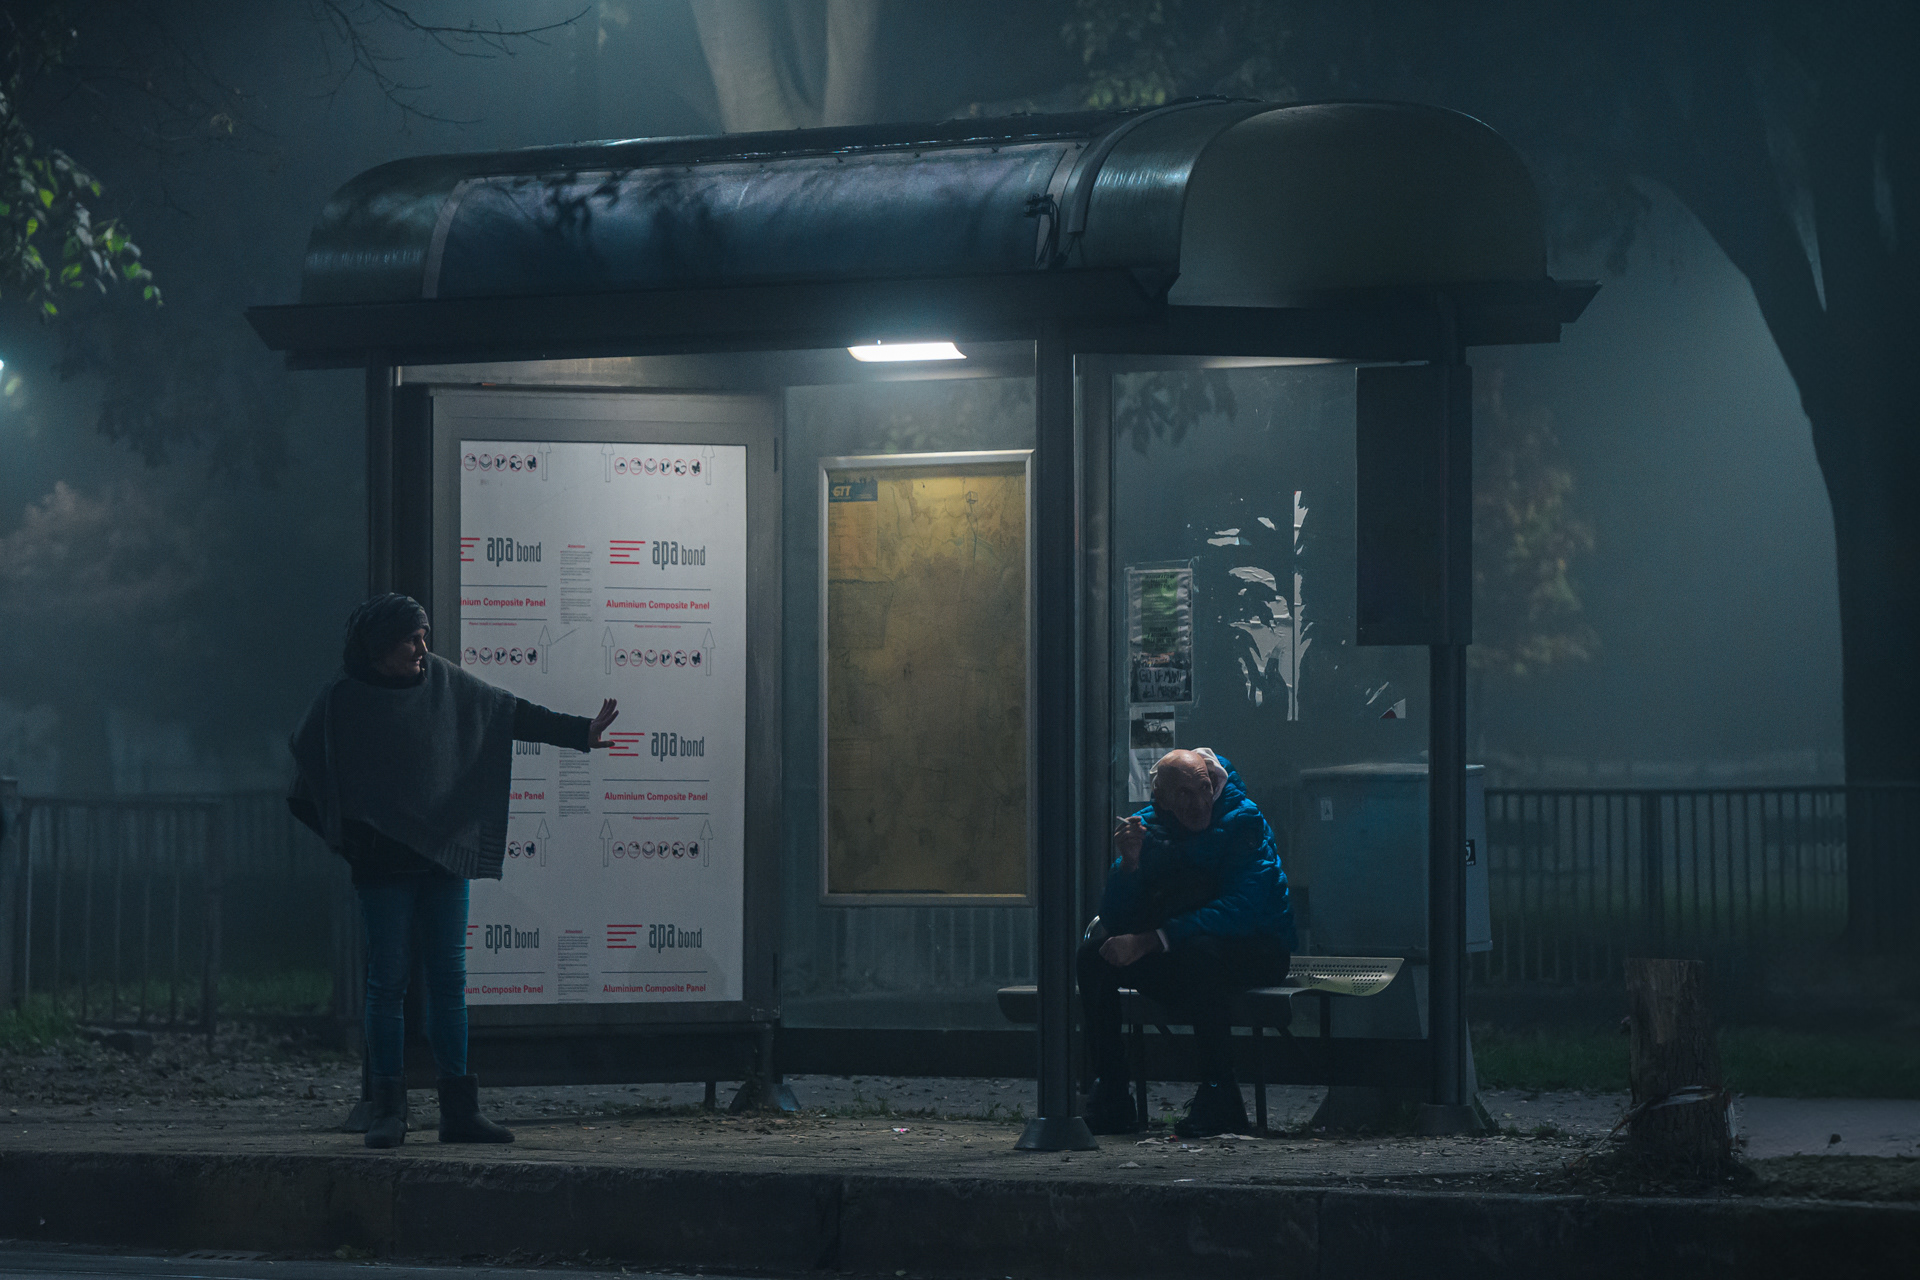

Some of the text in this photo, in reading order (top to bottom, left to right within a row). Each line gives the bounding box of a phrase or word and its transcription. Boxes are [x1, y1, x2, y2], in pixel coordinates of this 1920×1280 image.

[486, 536, 542, 568] apa bond
[652, 540, 706, 571] apa bond
[482, 597, 524, 609] Composite
[524, 597, 547, 608] Panel
[605, 599, 710, 611] Aluminium Composite Panel
[650, 731, 705, 763] apa bond
[523, 791, 545, 801] Panel
[603, 791, 708, 803] Aluminium Composite Panel
[485, 924, 540, 955] apa bond
[648, 923, 703, 954] apa bond
[481, 985, 523, 995] Composite
[522, 984, 544, 993] Panel
[602, 983, 707, 995] Aluminium Composite Panel
